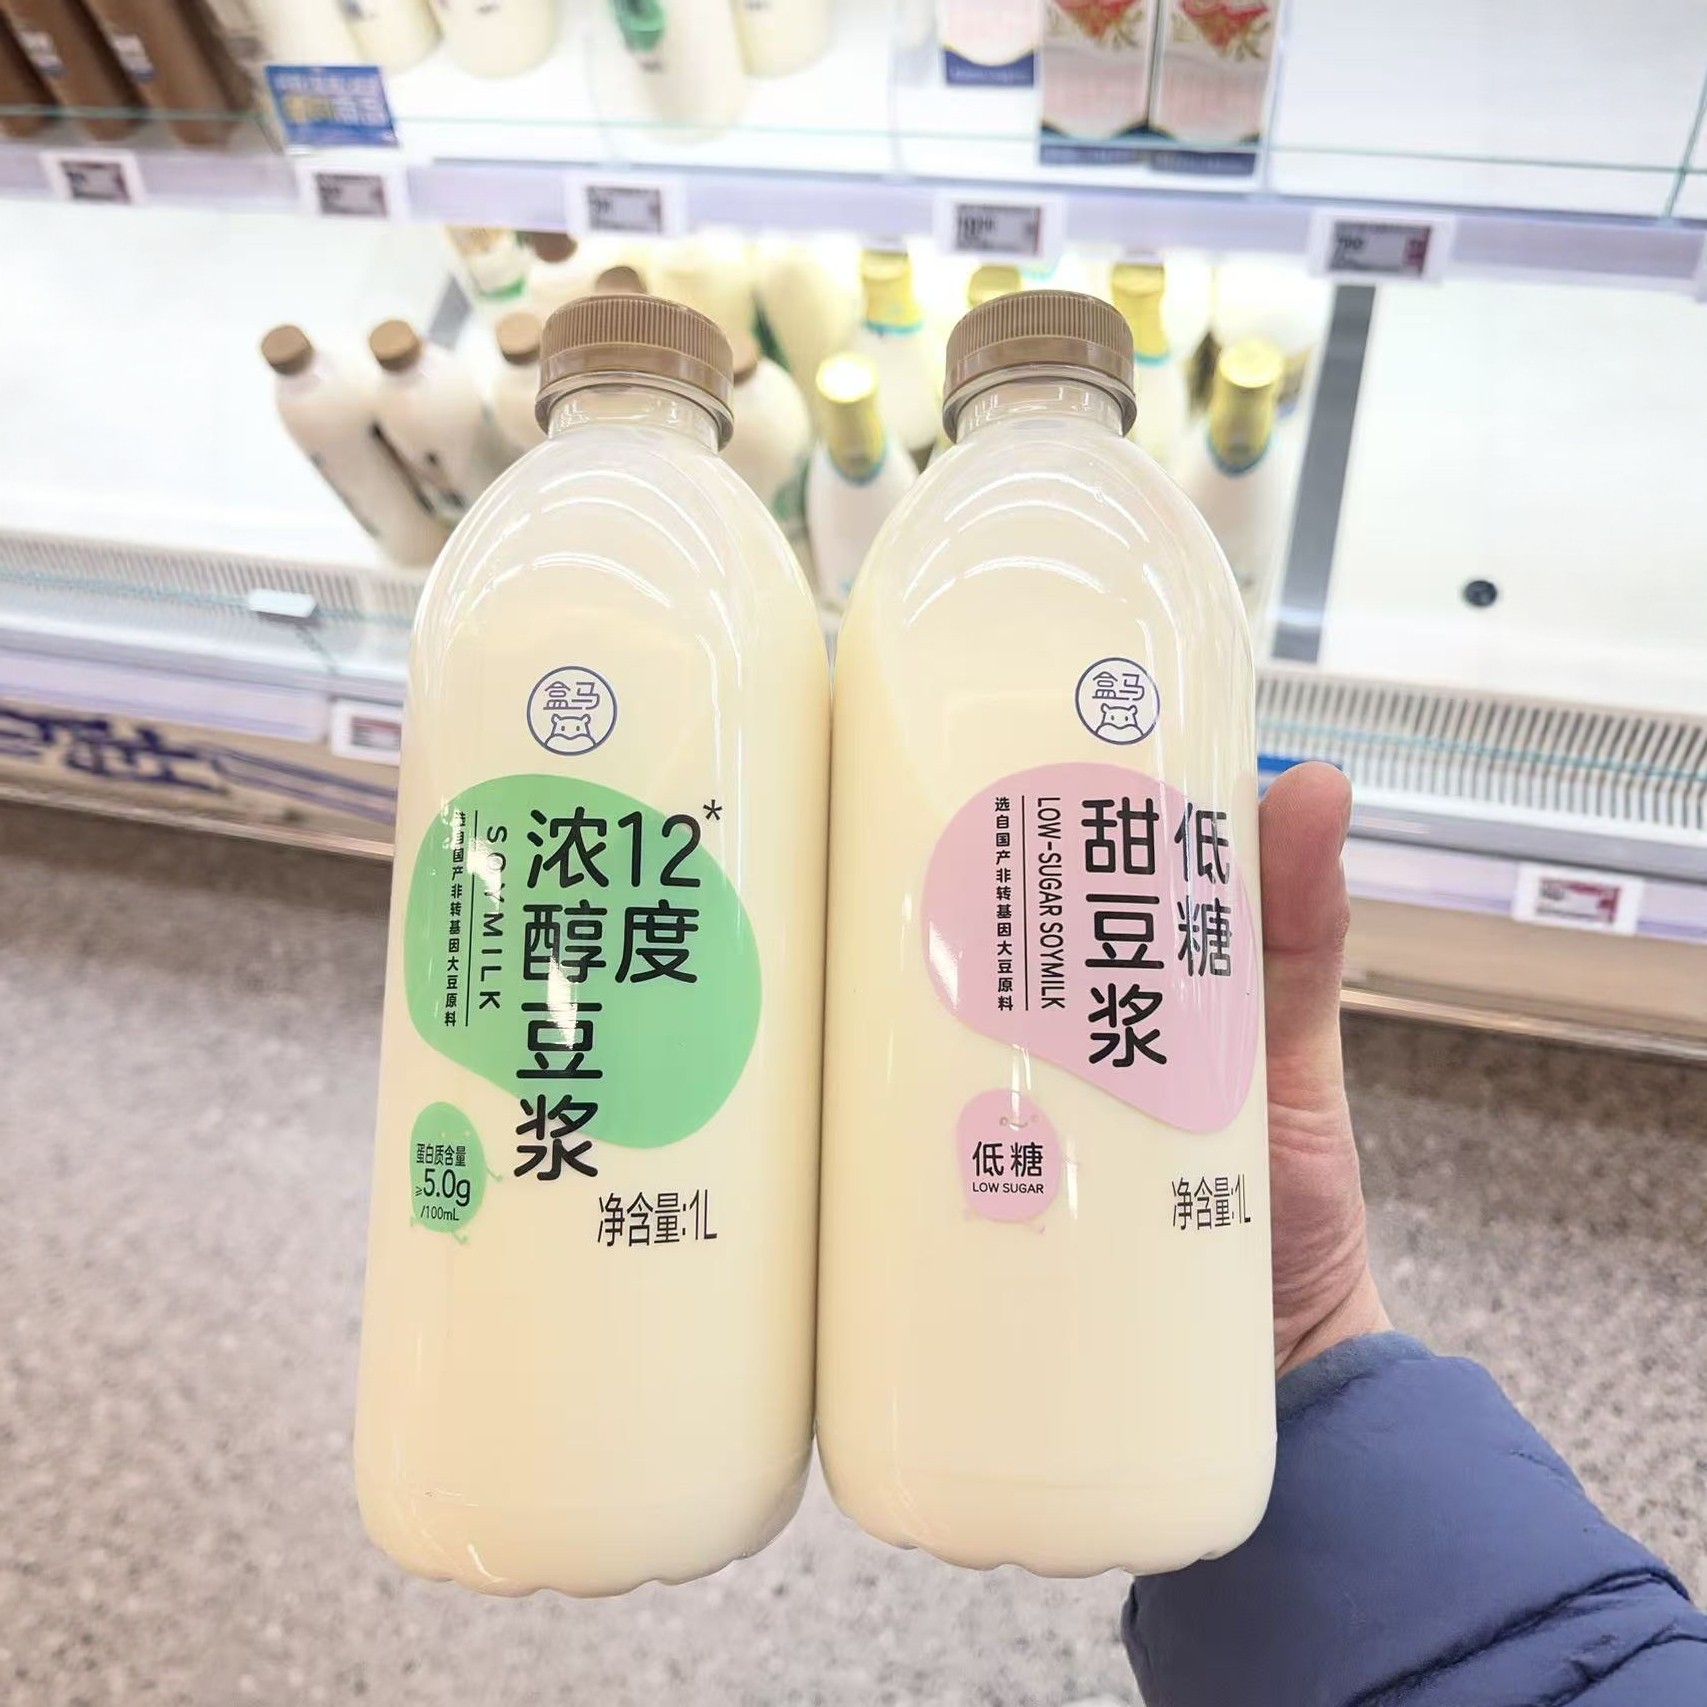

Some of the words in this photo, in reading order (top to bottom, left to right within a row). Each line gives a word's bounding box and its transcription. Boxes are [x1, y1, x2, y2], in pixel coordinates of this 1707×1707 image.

[543, 681, 600, 711] 盒马
[1092, 671, 1145, 701] 盒马
[1037, 797, 1063, 917] LOW-SUGAR
[1174, 802, 1232, 977] 低糖
[479, 825, 508, 1010] SOYMILK
[995, 796, 1014, 1012] 选自国产非转基因大豆原料
[1081, 796, 1167, 1068] 甜豆浆
[514, 806, 610, 1181] 浓醇豆浆
[1039, 921, 1065, 1010] SOYMILK
[416, 1143, 466, 1167] 蛋白质含量
[972, 1141, 1044, 1178] 低糖
[972, 1182, 1000, 1194] LOW
[1002, 1182, 1044, 1195] SUGAR
[421, 1205, 460, 1221] /100mL
